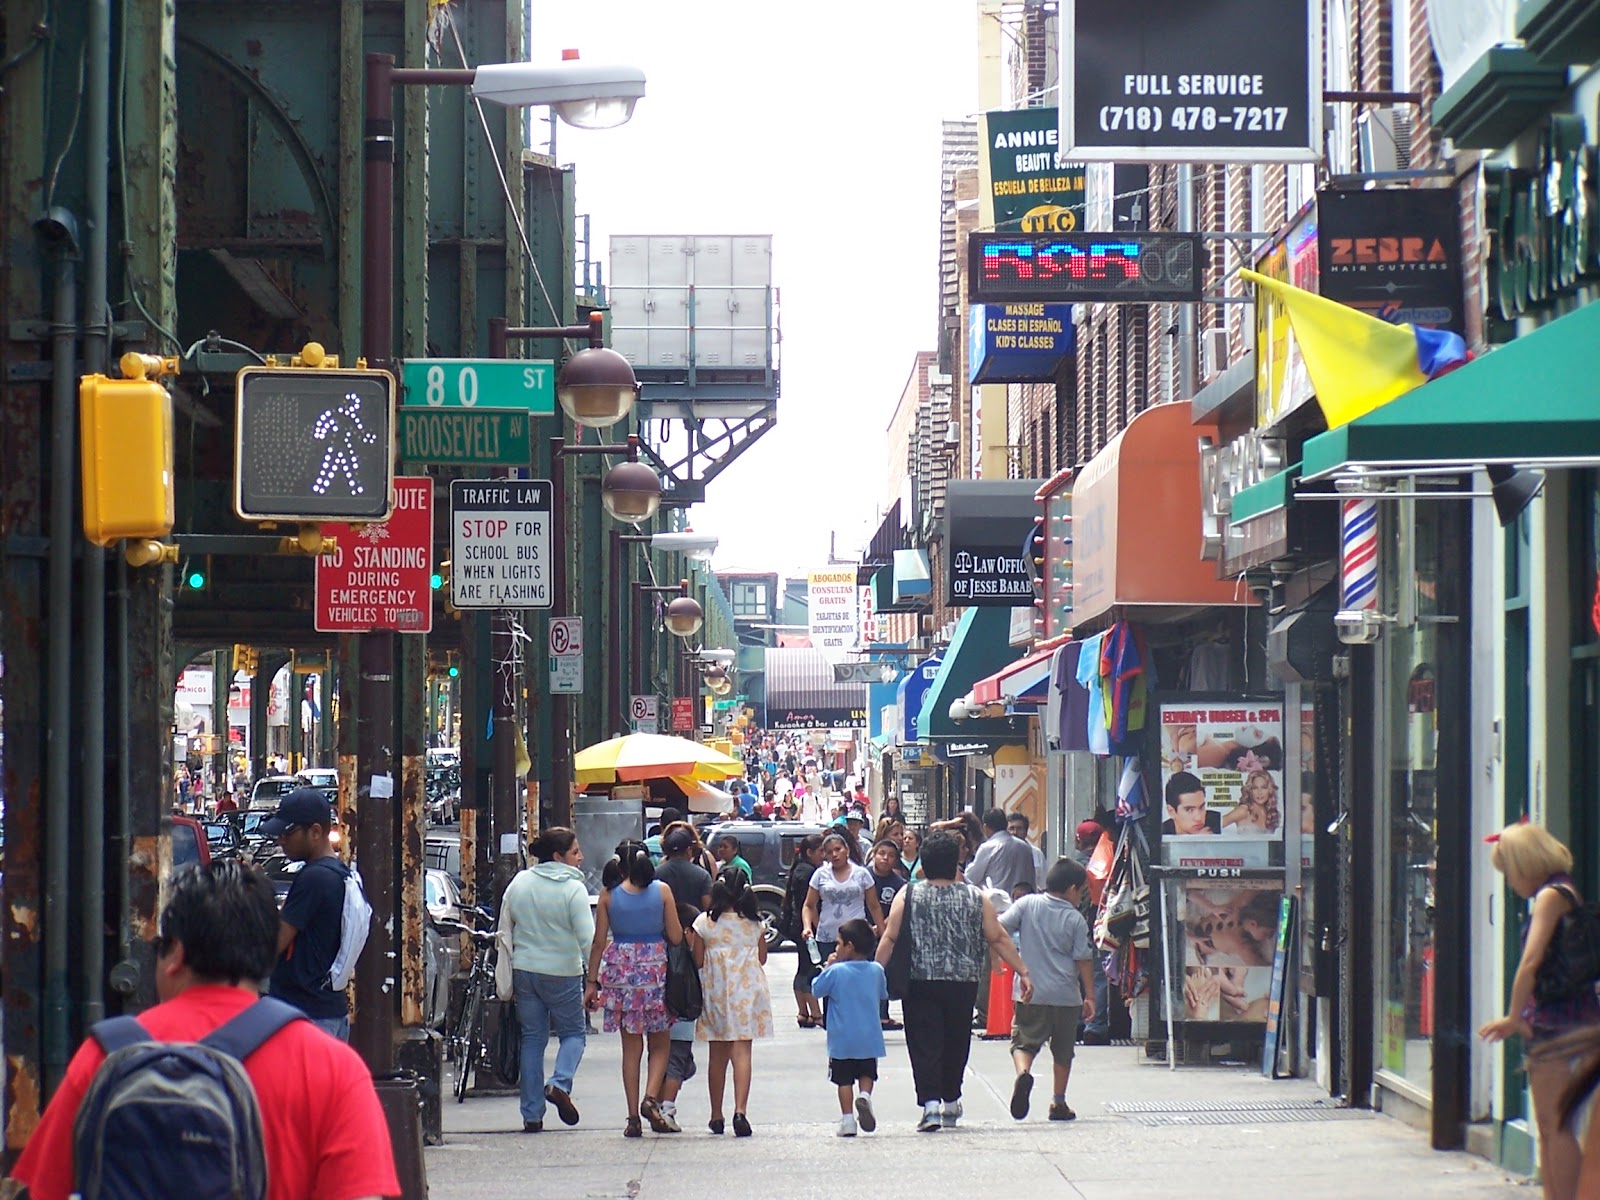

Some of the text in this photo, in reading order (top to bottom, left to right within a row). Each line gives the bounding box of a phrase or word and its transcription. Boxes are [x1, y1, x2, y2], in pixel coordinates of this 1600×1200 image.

[1124, 75, 1263, 95] FULL SERVICE
[1099, 106, 1289, 132] (718) 478-7217
[1015, 152, 1051, 173] BEAUTY
[993, 179, 1026, 196] ESCUELA
[1028, 178, 1039, 193] DE
[1040, 176, 1071, 192] BELLEZA
[1331, 236, 1447, 264] ZEBRA
[1331, 262, 1448, 272] HAIR CUTTERS
[1005, 304, 1045, 317] MASSAGE
[987, 317, 1063, 333] CLASES EN ESPAÑOL
[995, 335, 1054, 349] KID'S CLASSES
[523, 368, 545, 389] ST
[405, 415, 522, 458] ROOSEVELT AV
[463, 488, 541, 504] TRAFFIC LAW
[462, 520, 541, 538] STOP FOR
[322, 546, 426, 569] NO STANDING
[465, 545, 539, 560] SCHOOL BUS
[463, 565, 541, 579] WHEN LIGHTS
[973, 556, 1027, 574] LAW OFFIC
[348, 572, 399, 586] DURING
[813, 573, 852, 583] ABOGADOS
[460, 585, 545, 599] ARE FLASHING
[811, 586, 853, 595] CONSULTAS
[954, 580, 967, 593] OF
[968, 578, 998, 599] JESSE
[330, 589, 416, 605] EMERGENCY
[819, 597, 846, 605] GRATIS
[328, 607, 377, 623] VEHICLES
[823, 638, 843, 647] GRATIS
[774, 721, 805, 729] Karaoke
[833, 720, 851, 728] Cafe
[1197, 868, 1241, 877] PUSH
